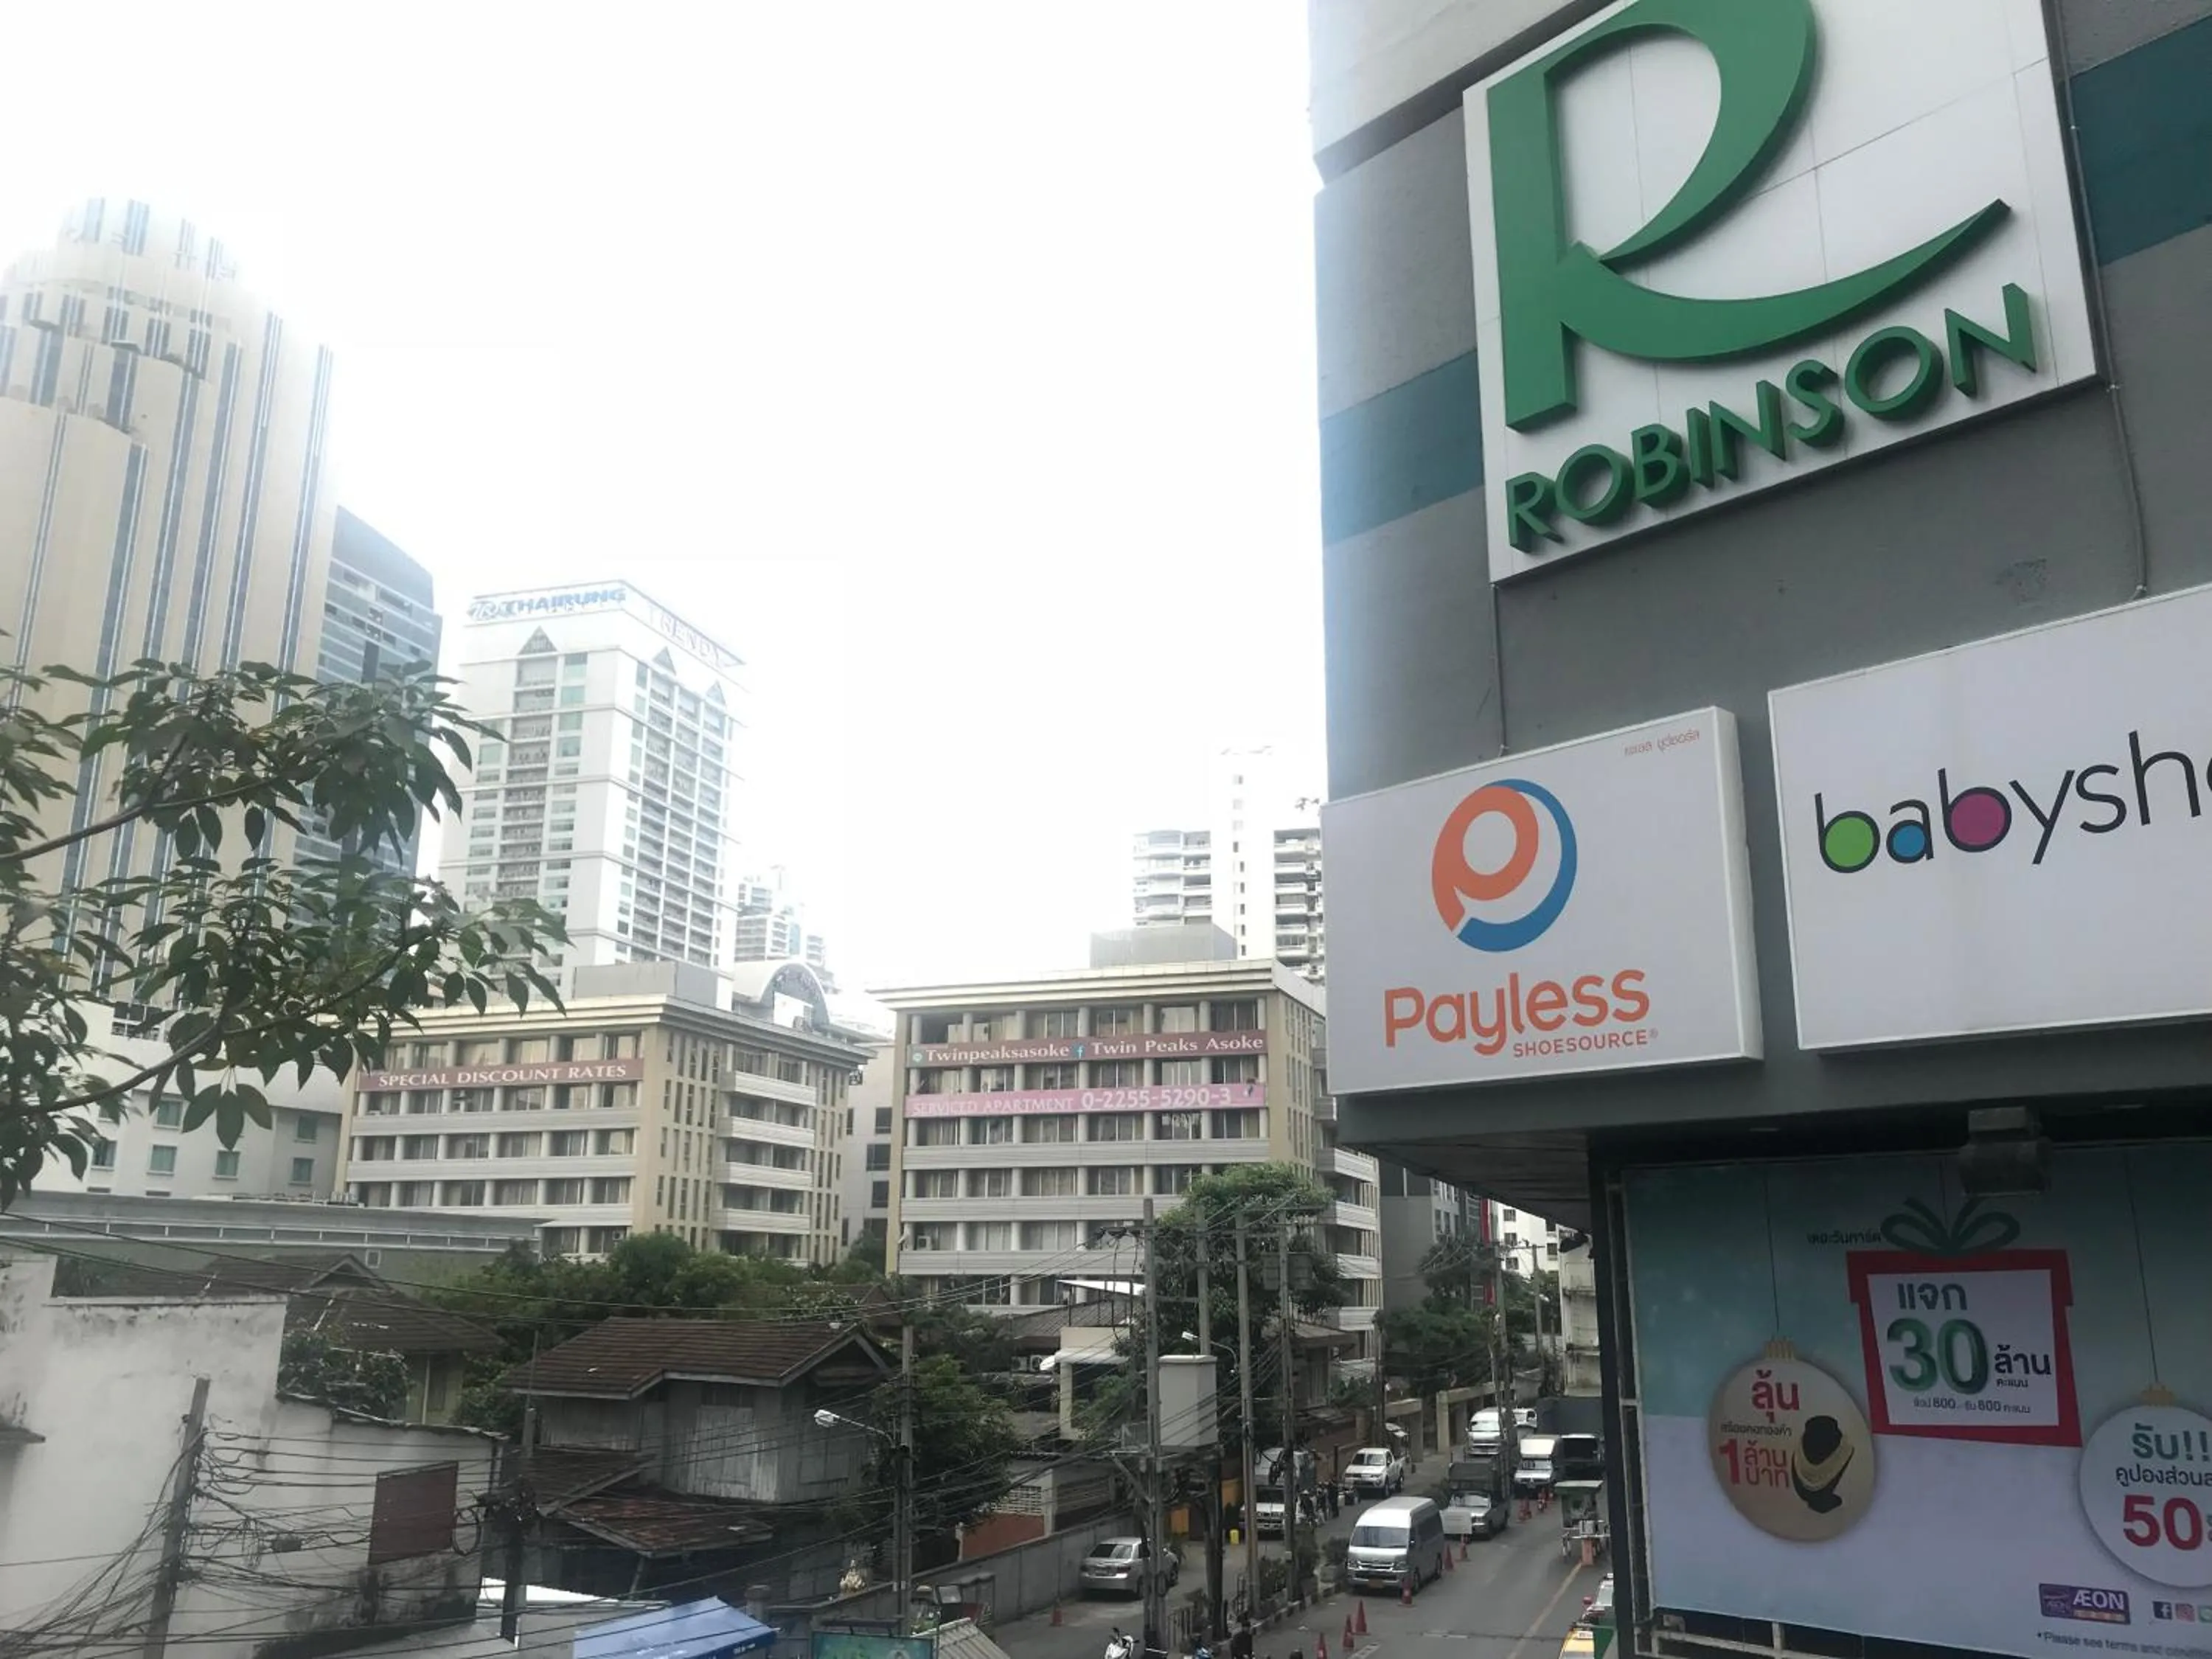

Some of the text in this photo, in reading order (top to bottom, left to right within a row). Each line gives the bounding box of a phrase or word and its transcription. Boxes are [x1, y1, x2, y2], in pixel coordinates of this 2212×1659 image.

[1505, 282, 2037, 553] ROBINSON
[1815, 730, 2212, 873] babysh
[1384, 970, 1650, 1056] Payless
[926, 1043, 1070, 1064] Twinpeaksasoke
[1091, 1040, 1137, 1054] Twin
[1145, 1039, 1198, 1053] Peaks
[1206, 1035, 1264, 1050] Asoke
[378, 1065, 627, 1088] SPECIAL DISCOUNT RATES
[911, 1101, 978, 1116] SERVICED
[982, 1097, 1074, 1113] APARTMENT
[1897, 1283, 1967, 1310] แจก
[1887, 1318, 2052, 1395] 30 ล้าน
[1752, 1369, 1800, 1423] ลุ้น
[1719, 1439, 1787, 1485] 1 ล้าน
[2132, 1422, 2211, 1462] รับ!!
[1746, 1467, 1790, 1488] บาท
[2123, 1495, 2203, 1551] 50
